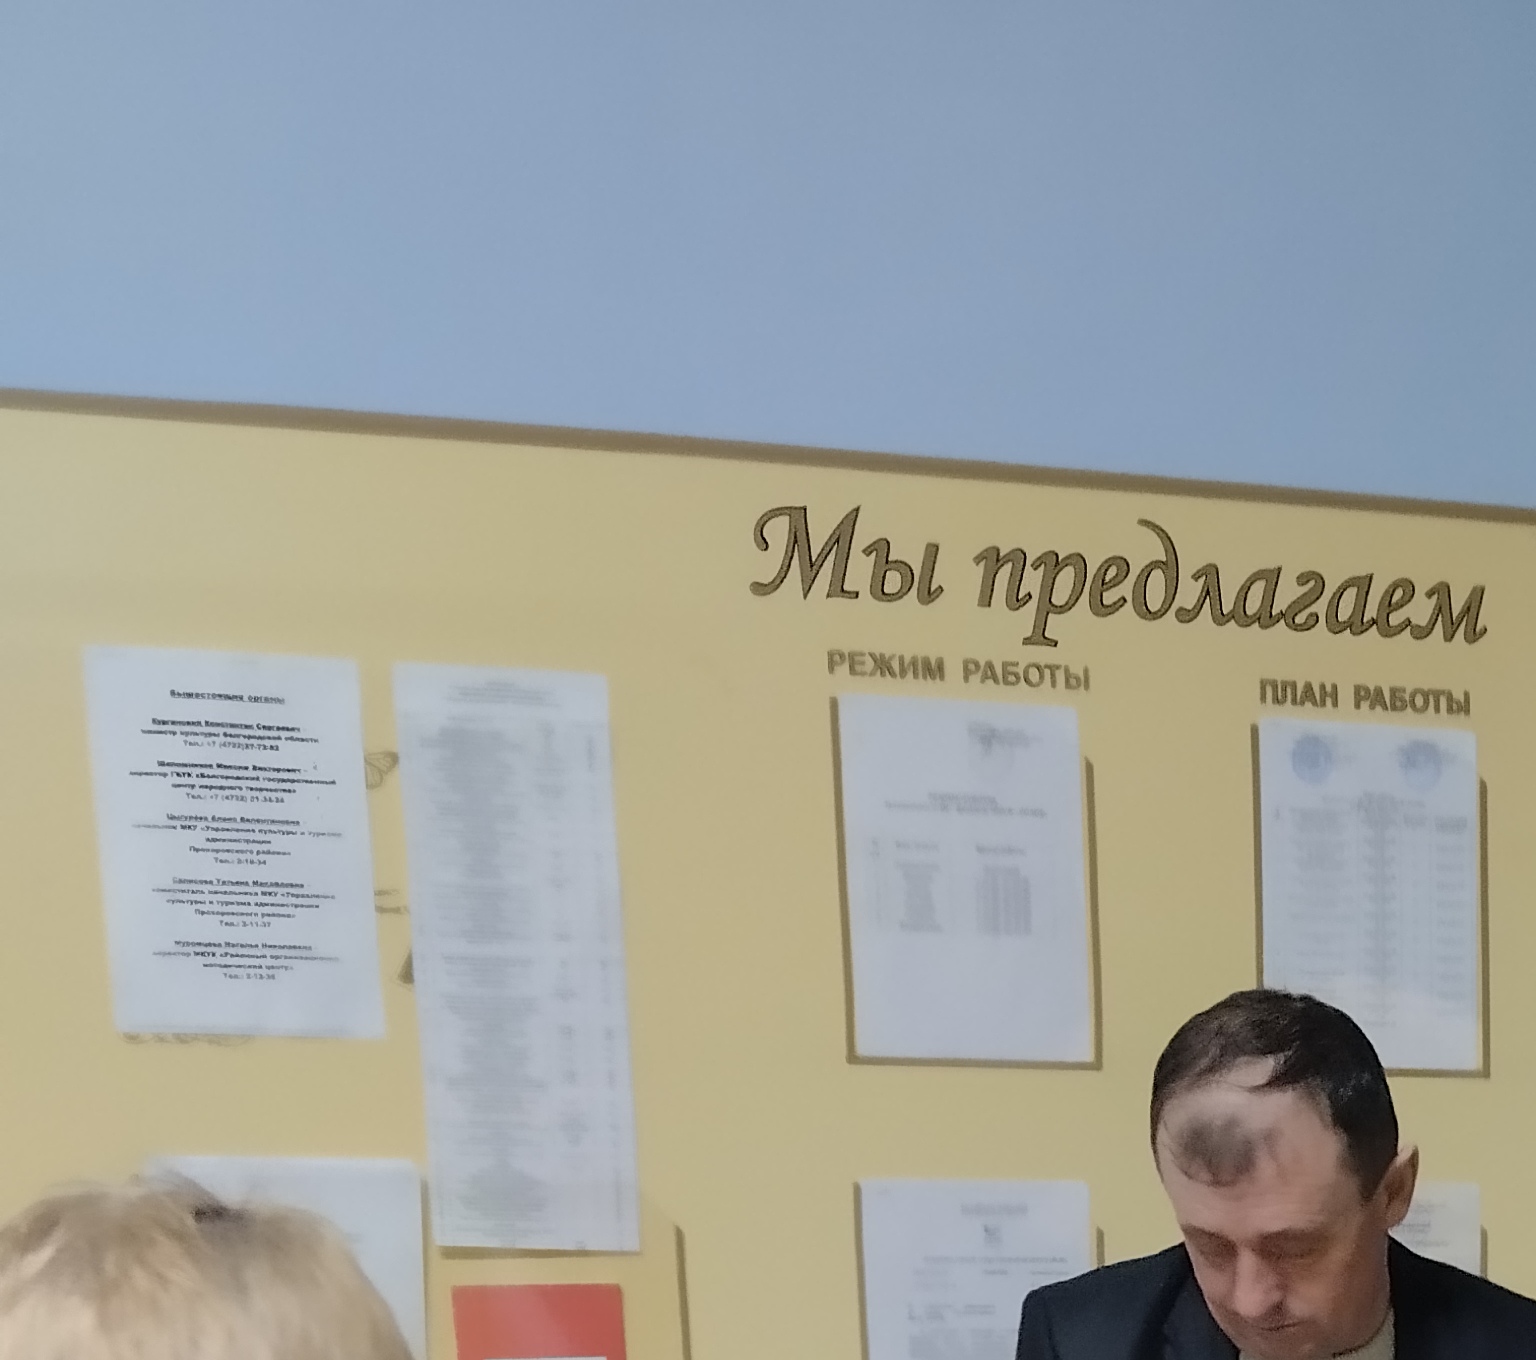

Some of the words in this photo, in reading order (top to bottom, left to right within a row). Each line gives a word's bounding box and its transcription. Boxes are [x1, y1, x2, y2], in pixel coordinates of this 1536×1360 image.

[750, 504, 944, 606] Мы
[972, 517, 1488, 648] предлагаем
[827, 649, 946, 682] РЕЖИМ
[962, 656, 1091, 692] РАБОТЫ
[1259, 677, 1339, 709] ПЛАН
[1353, 683, 1471, 716] РАБОТЫ
